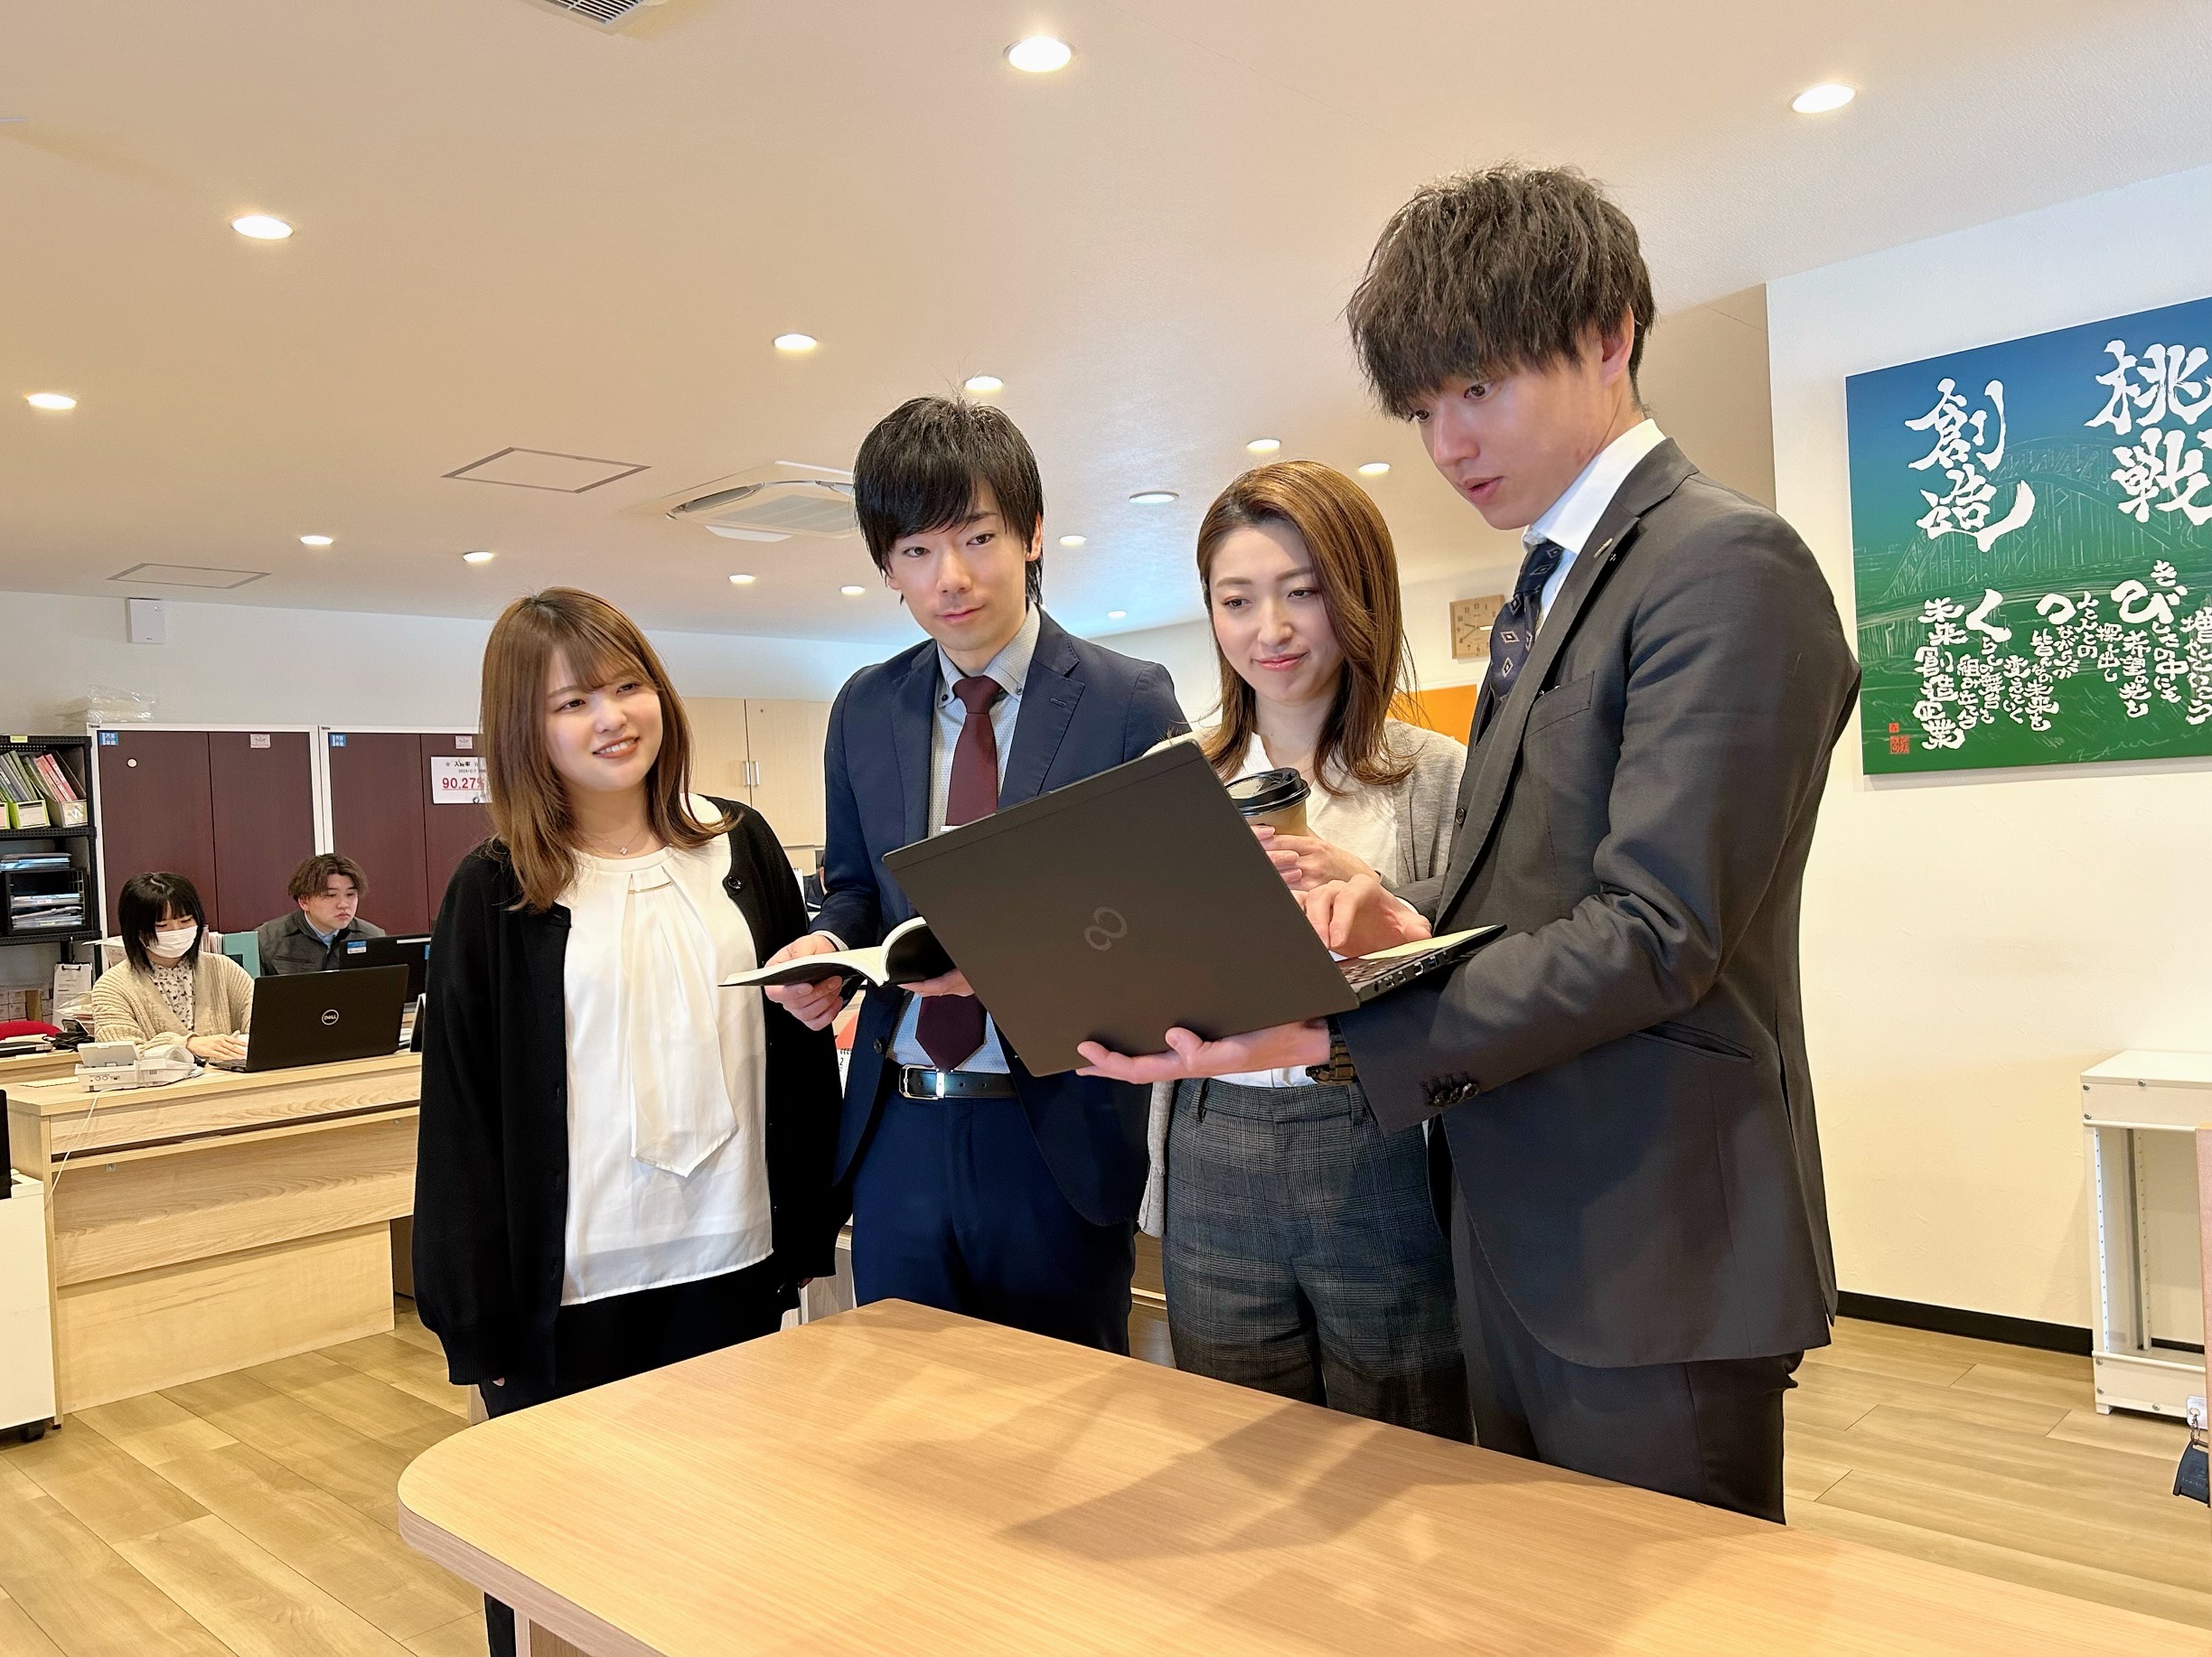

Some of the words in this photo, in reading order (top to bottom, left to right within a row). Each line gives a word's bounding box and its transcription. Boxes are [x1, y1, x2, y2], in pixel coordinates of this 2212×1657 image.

[1905, 378, 2036, 553] 創造
[1912, 596, 1970, 751] 未来創造企業
[442, 778, 485, 789] 90.27%
